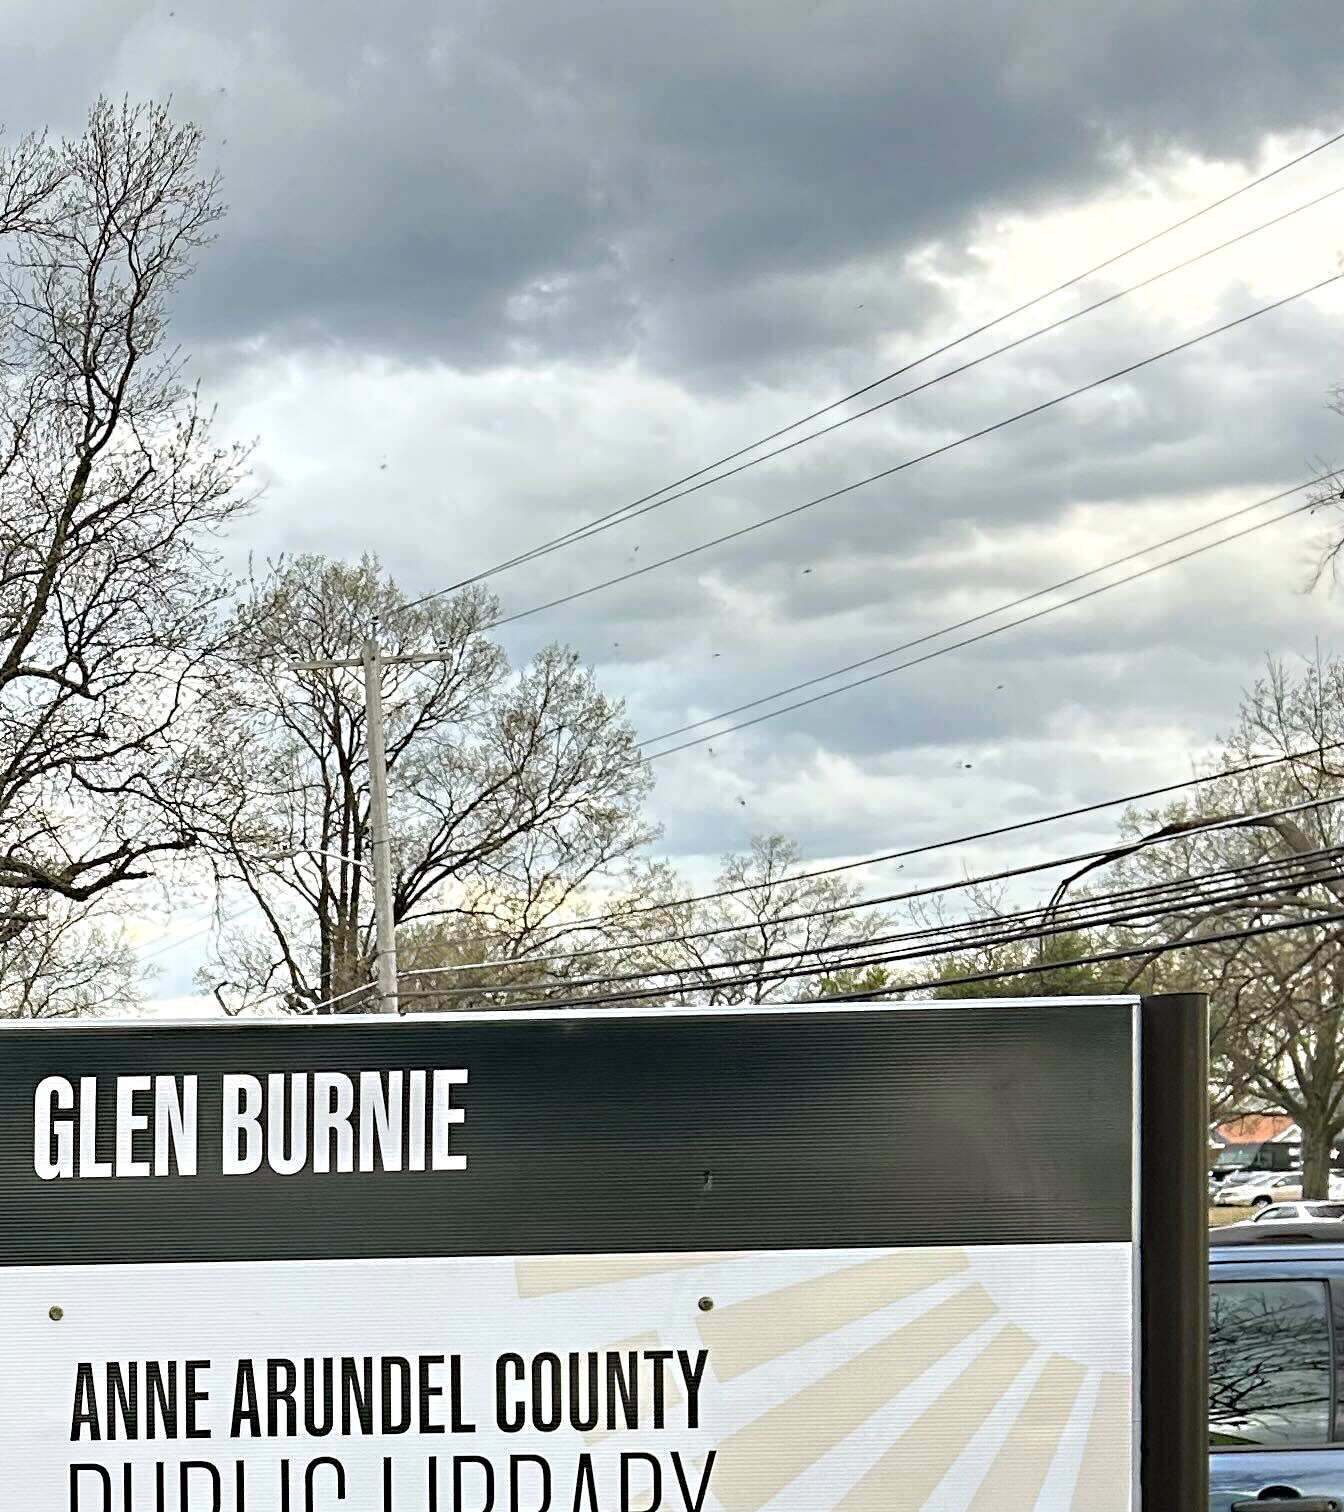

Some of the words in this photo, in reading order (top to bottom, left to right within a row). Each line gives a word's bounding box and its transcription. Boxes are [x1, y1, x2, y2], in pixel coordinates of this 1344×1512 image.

[32, 1072, 199, 1181] GLEN
[220, 1068, 469, 1176] BURNIE
[69, 1359, 212, 1442] ANNE
[230, 1353, 476, 1438] ARUNDEL
[495, 1349, 709, 1434] COUNTY
